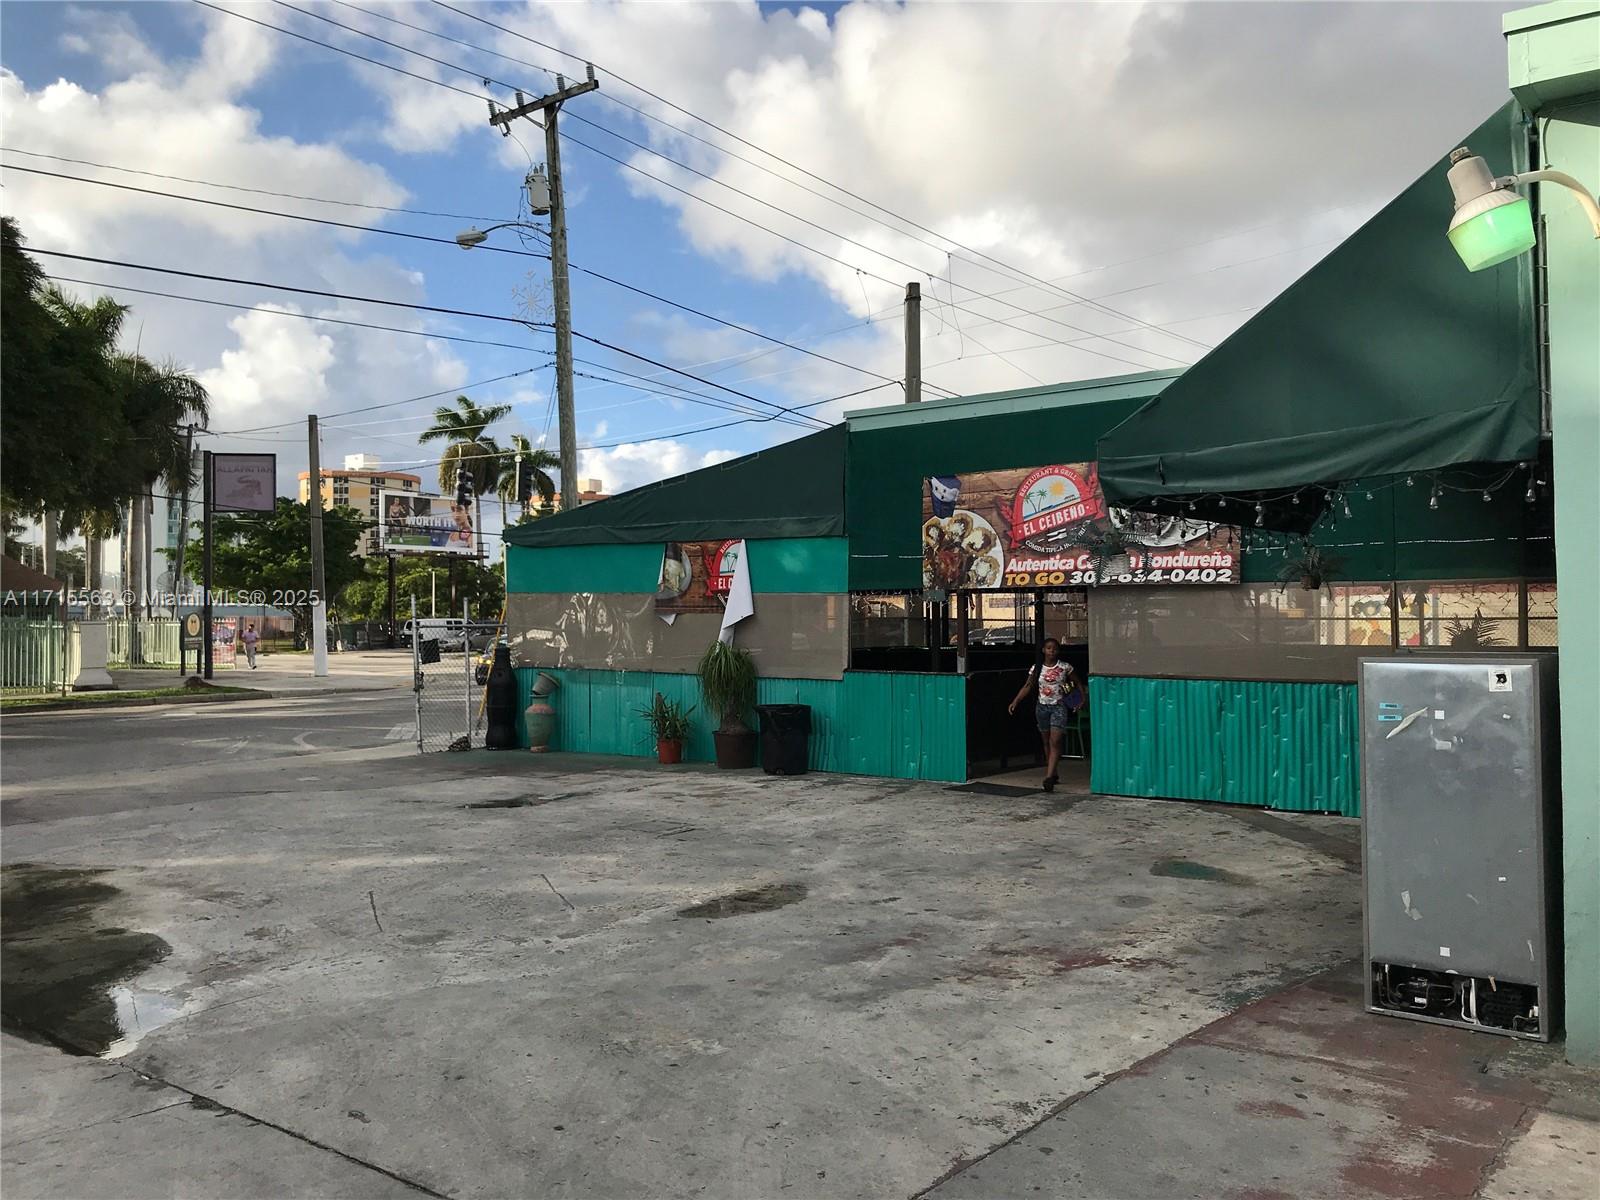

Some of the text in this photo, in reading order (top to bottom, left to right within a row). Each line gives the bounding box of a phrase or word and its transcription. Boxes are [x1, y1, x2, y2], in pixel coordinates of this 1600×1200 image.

[1020, 467, 1053, 497] RESTAURANT
[1060, 468, 1077, 481] GRILL
[405, 515, 441, 527] WORTH
[1023, 521, 1037, 537] EL
[1025, 540, 1046, 553] COMIDA
[1006, 555, 1074, 571] Autentica
[718, 578, 727, 589] EL
[1006, 573, 1030, 586] TO
[1034, 571, 1065, 586] GO
